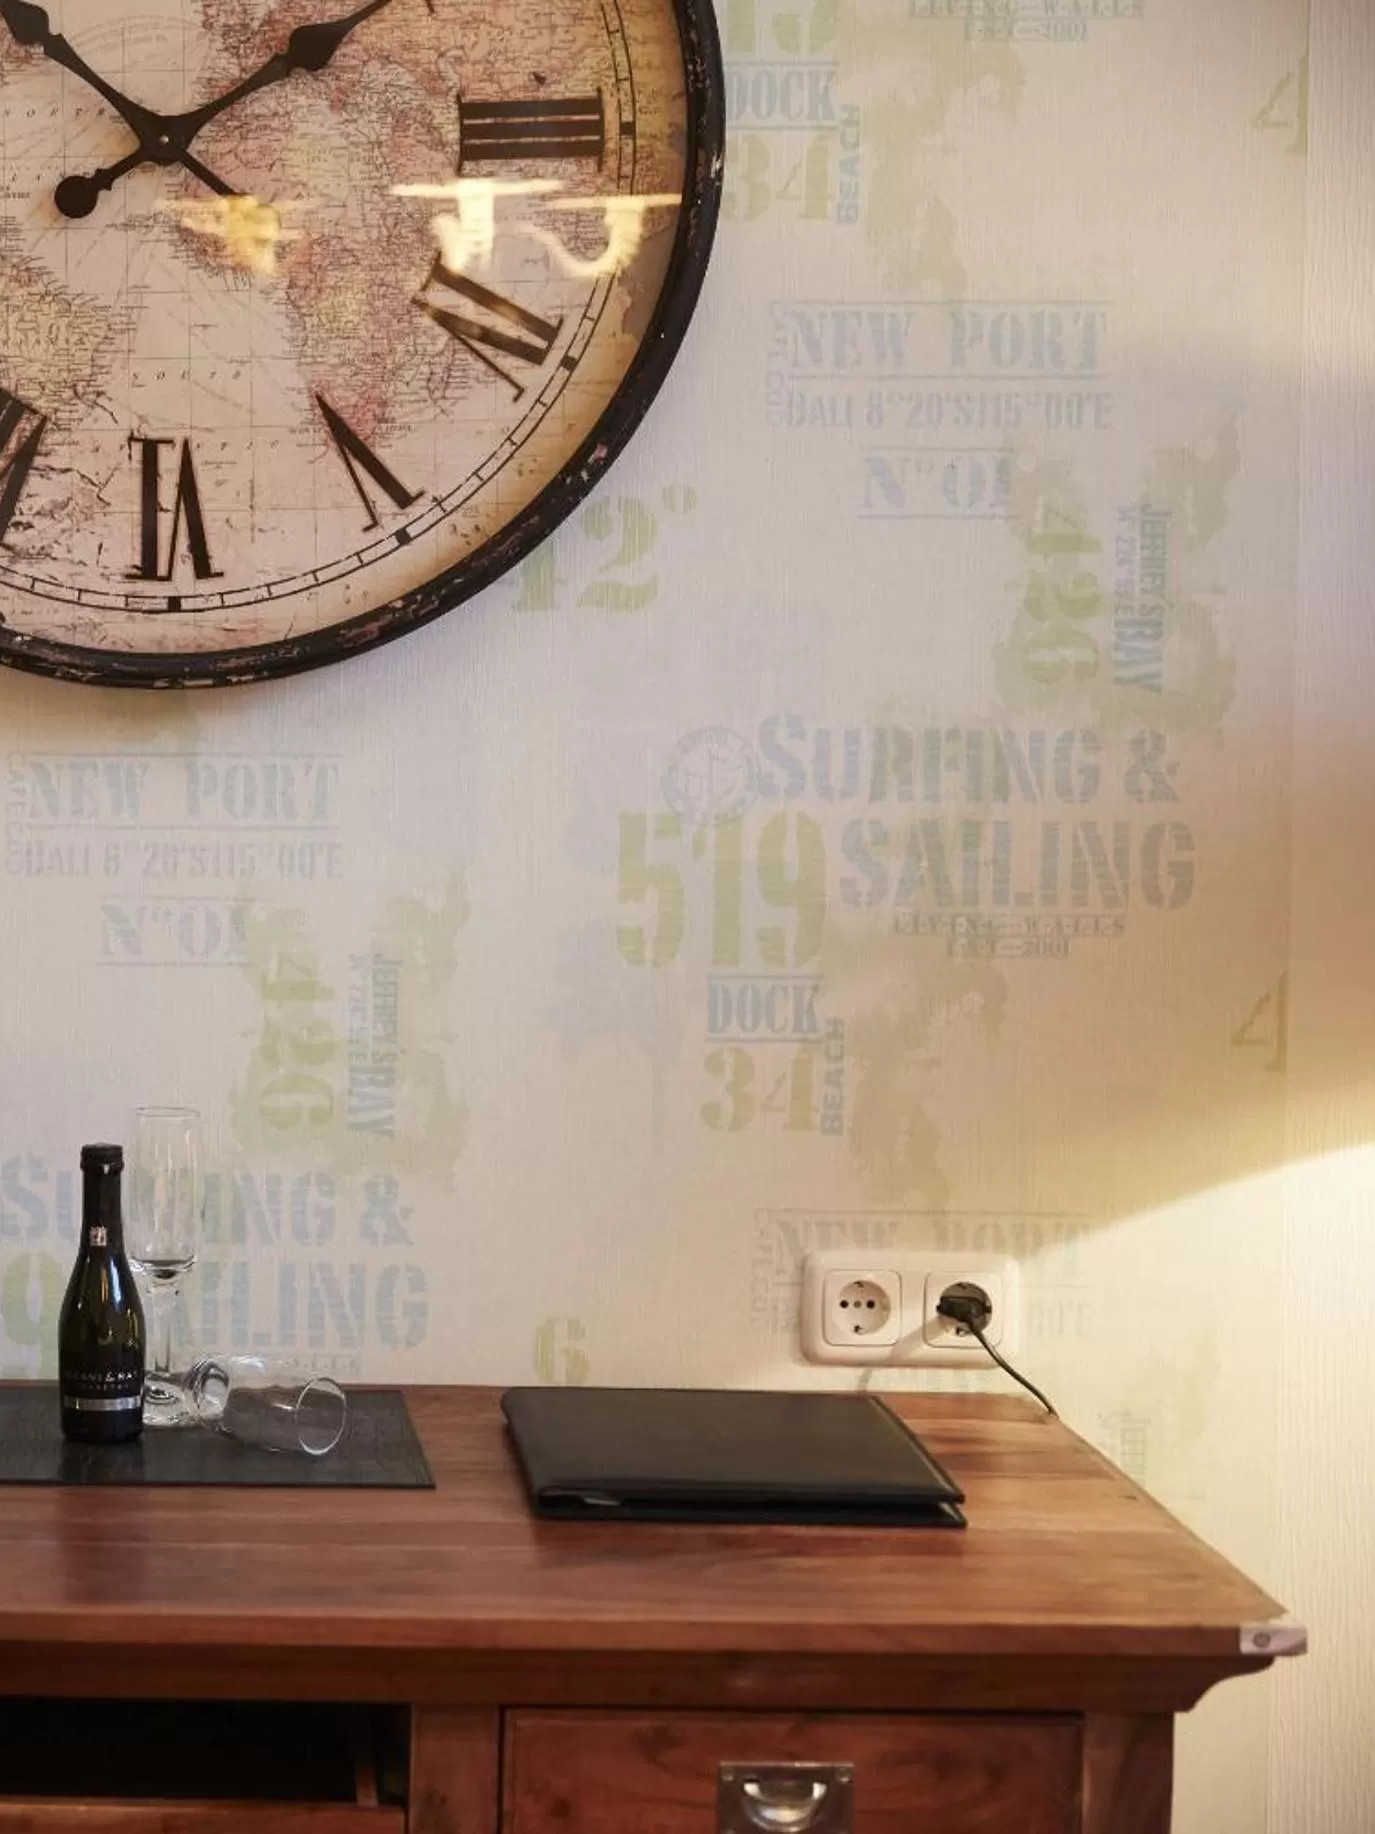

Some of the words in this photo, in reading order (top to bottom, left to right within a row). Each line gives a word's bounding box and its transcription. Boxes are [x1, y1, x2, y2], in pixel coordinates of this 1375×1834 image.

[837, 105, 861, 225] BEACH
[791, 310, 914, 368] NEW
[949, 311, 1108, 369] PORT
[27, 761, 151, 820] NEW
[184, 759, 339, 820] PORT
[755, 713, 1102, 803] SURFING
[1127, 729, 1182, 802] &
[615, 811, 824, 969] 519
[839, 818, 1196, 911] SAILING
[707, 983, 820, 1034] DOCK
[699, 1045, 816, 1134] 34
[820, 1017, 845, 1136] BEACH
[361, 1174, 415, 1246] &
